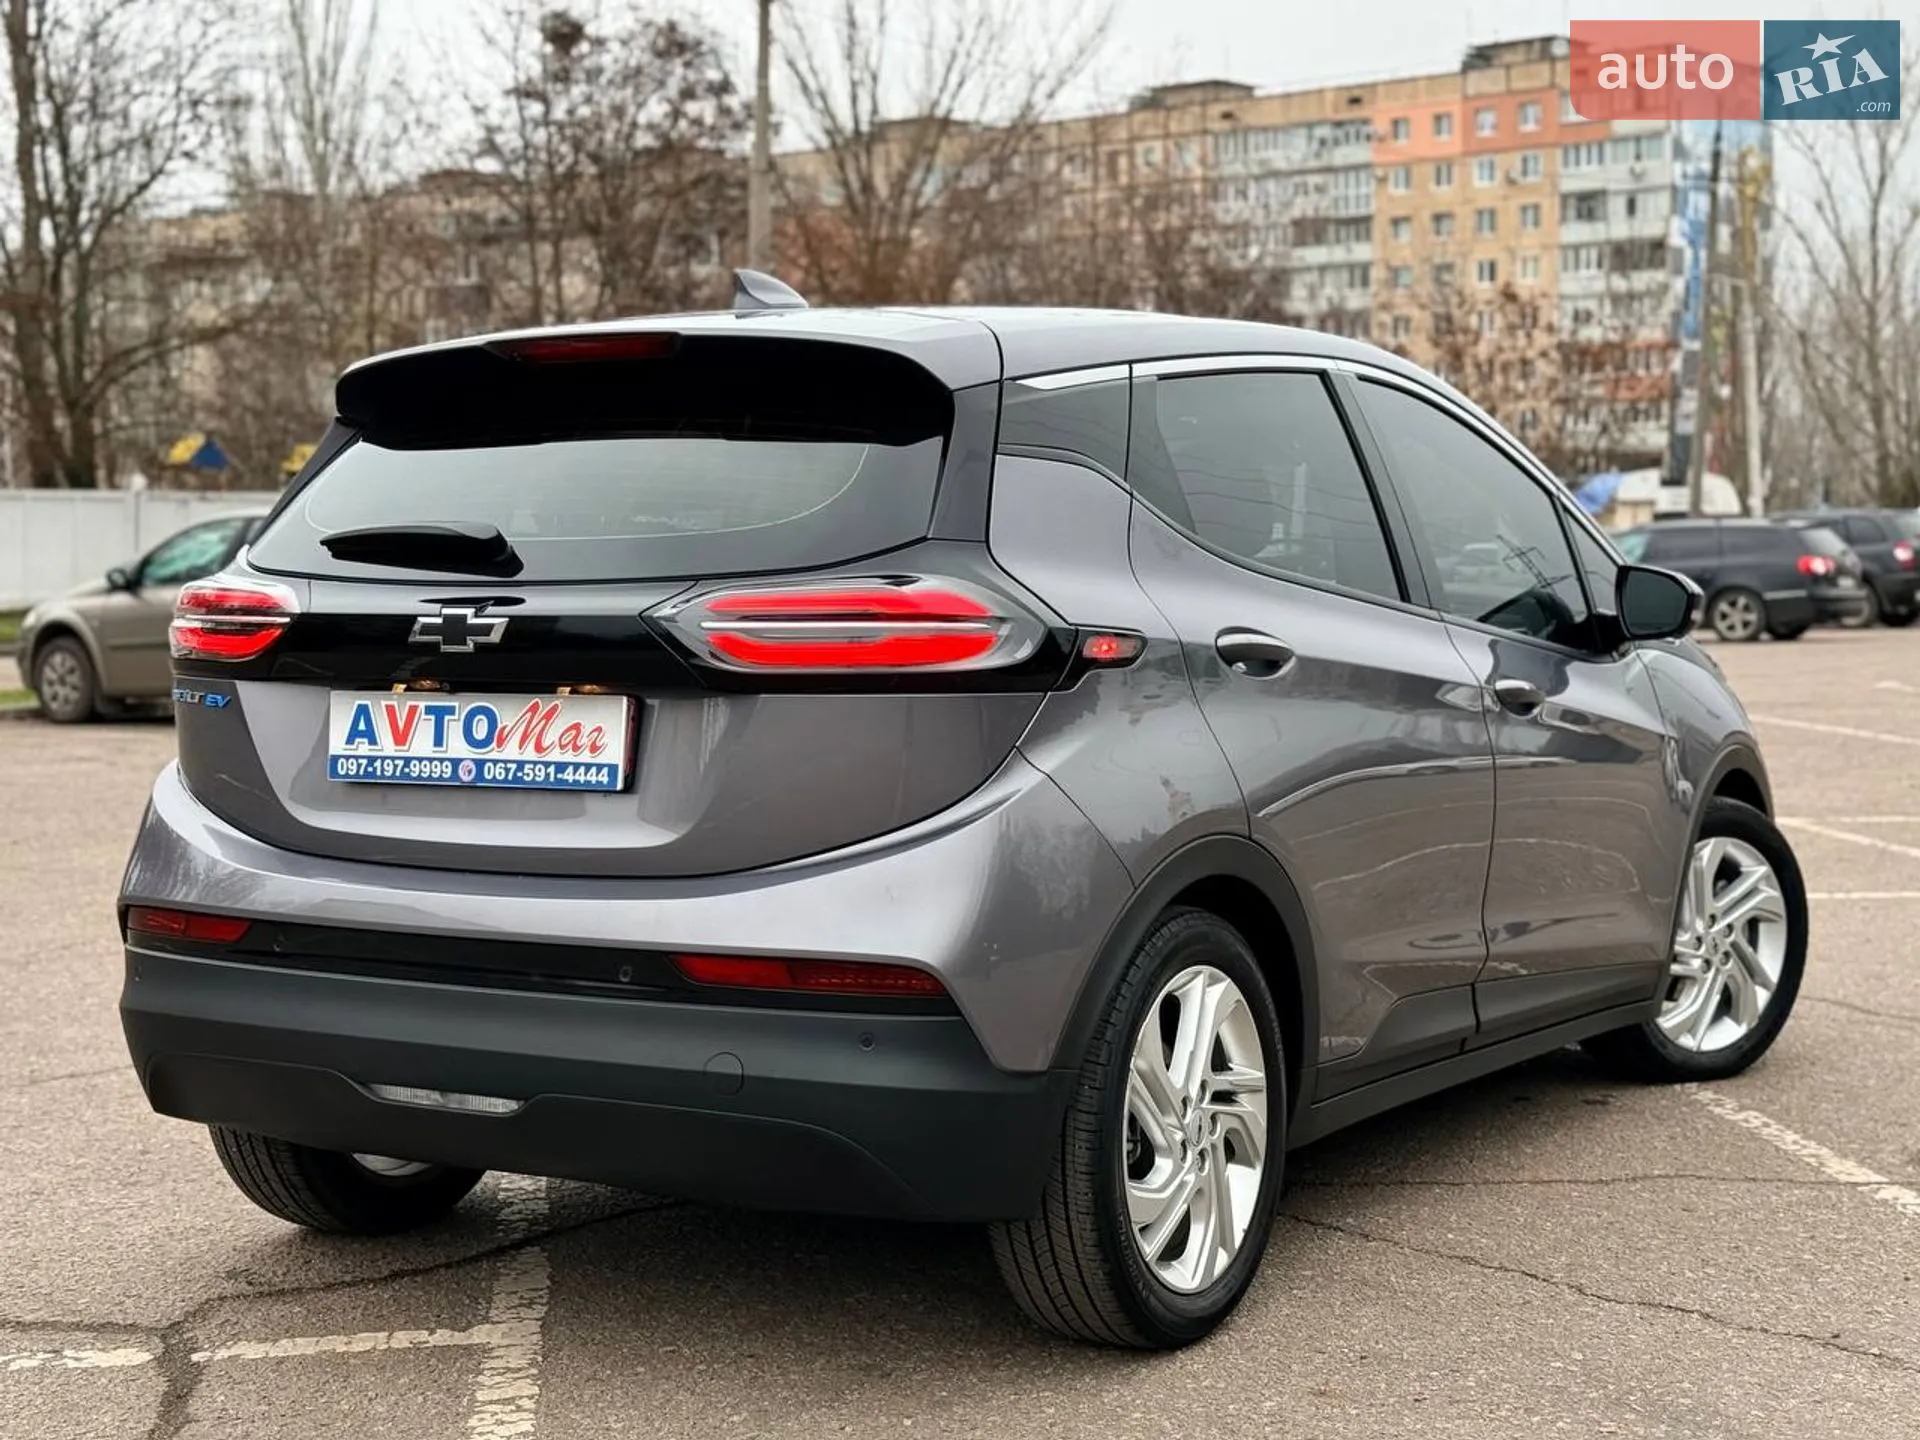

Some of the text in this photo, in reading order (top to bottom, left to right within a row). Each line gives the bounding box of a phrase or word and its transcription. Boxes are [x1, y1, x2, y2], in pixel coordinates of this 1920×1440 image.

[205, 694, 232, 707] EV
[337, 758, 609, 785] 097-197-9999 067-591-4444
